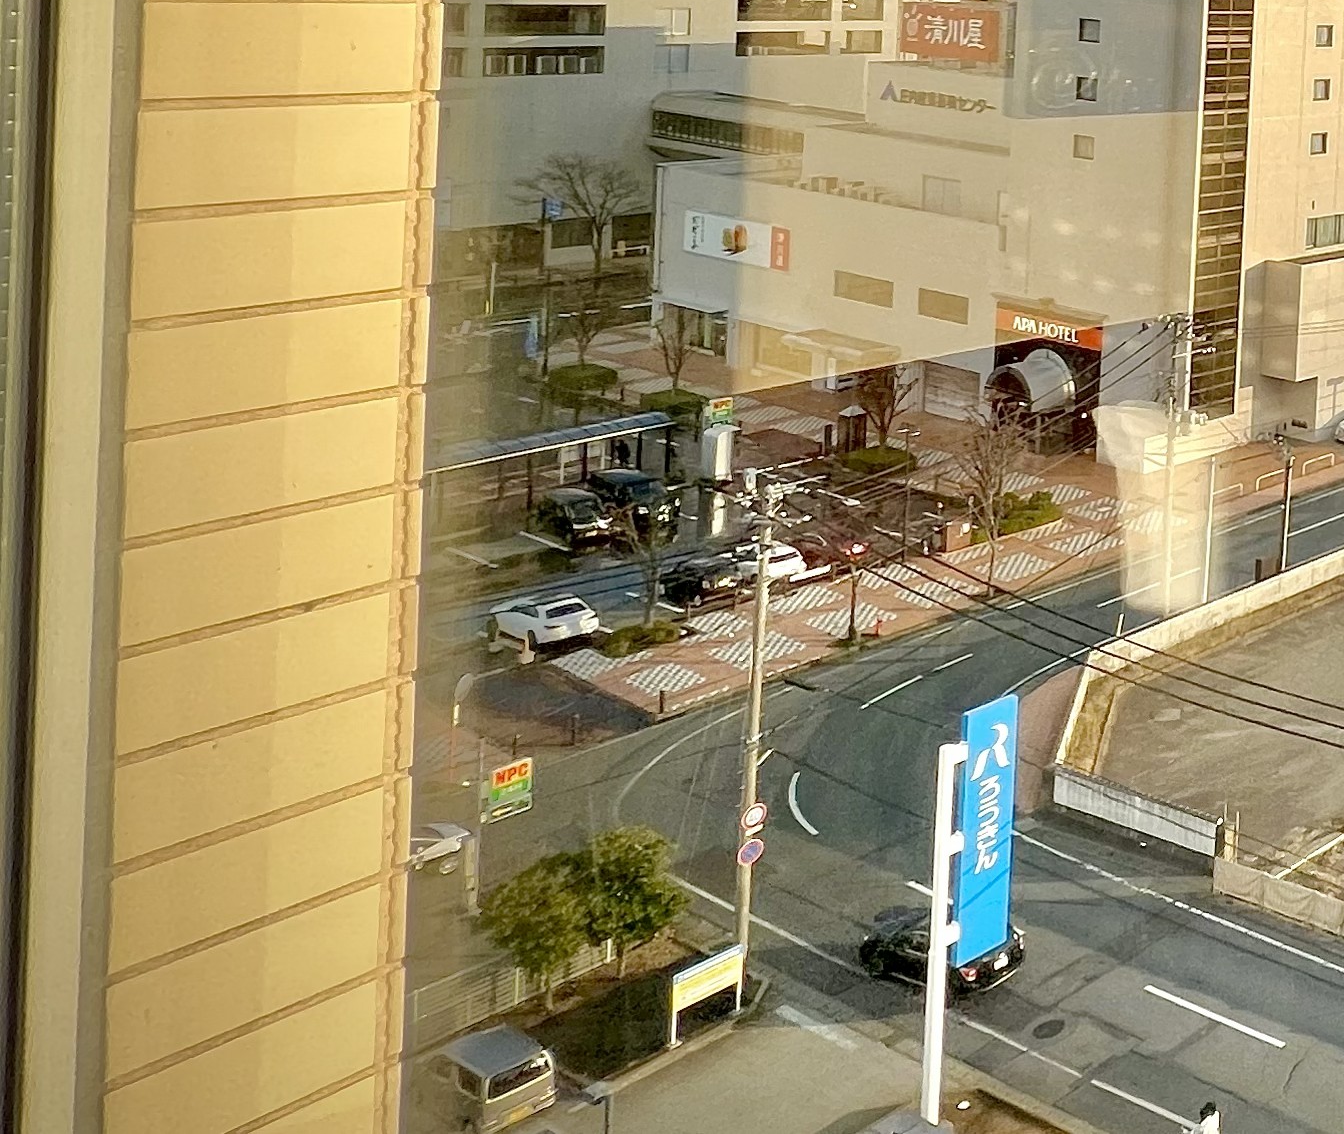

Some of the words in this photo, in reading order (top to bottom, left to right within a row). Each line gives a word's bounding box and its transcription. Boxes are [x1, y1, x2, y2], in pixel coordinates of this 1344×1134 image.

[923, 15, 986, 50] 清川屋
[1012, 316, 1038, 334] APA
[1038, 321, 1079, 343] HOTEL
[494, 762, 529, 786] NPC
[974, 774, 1002, 875] ろうきん
